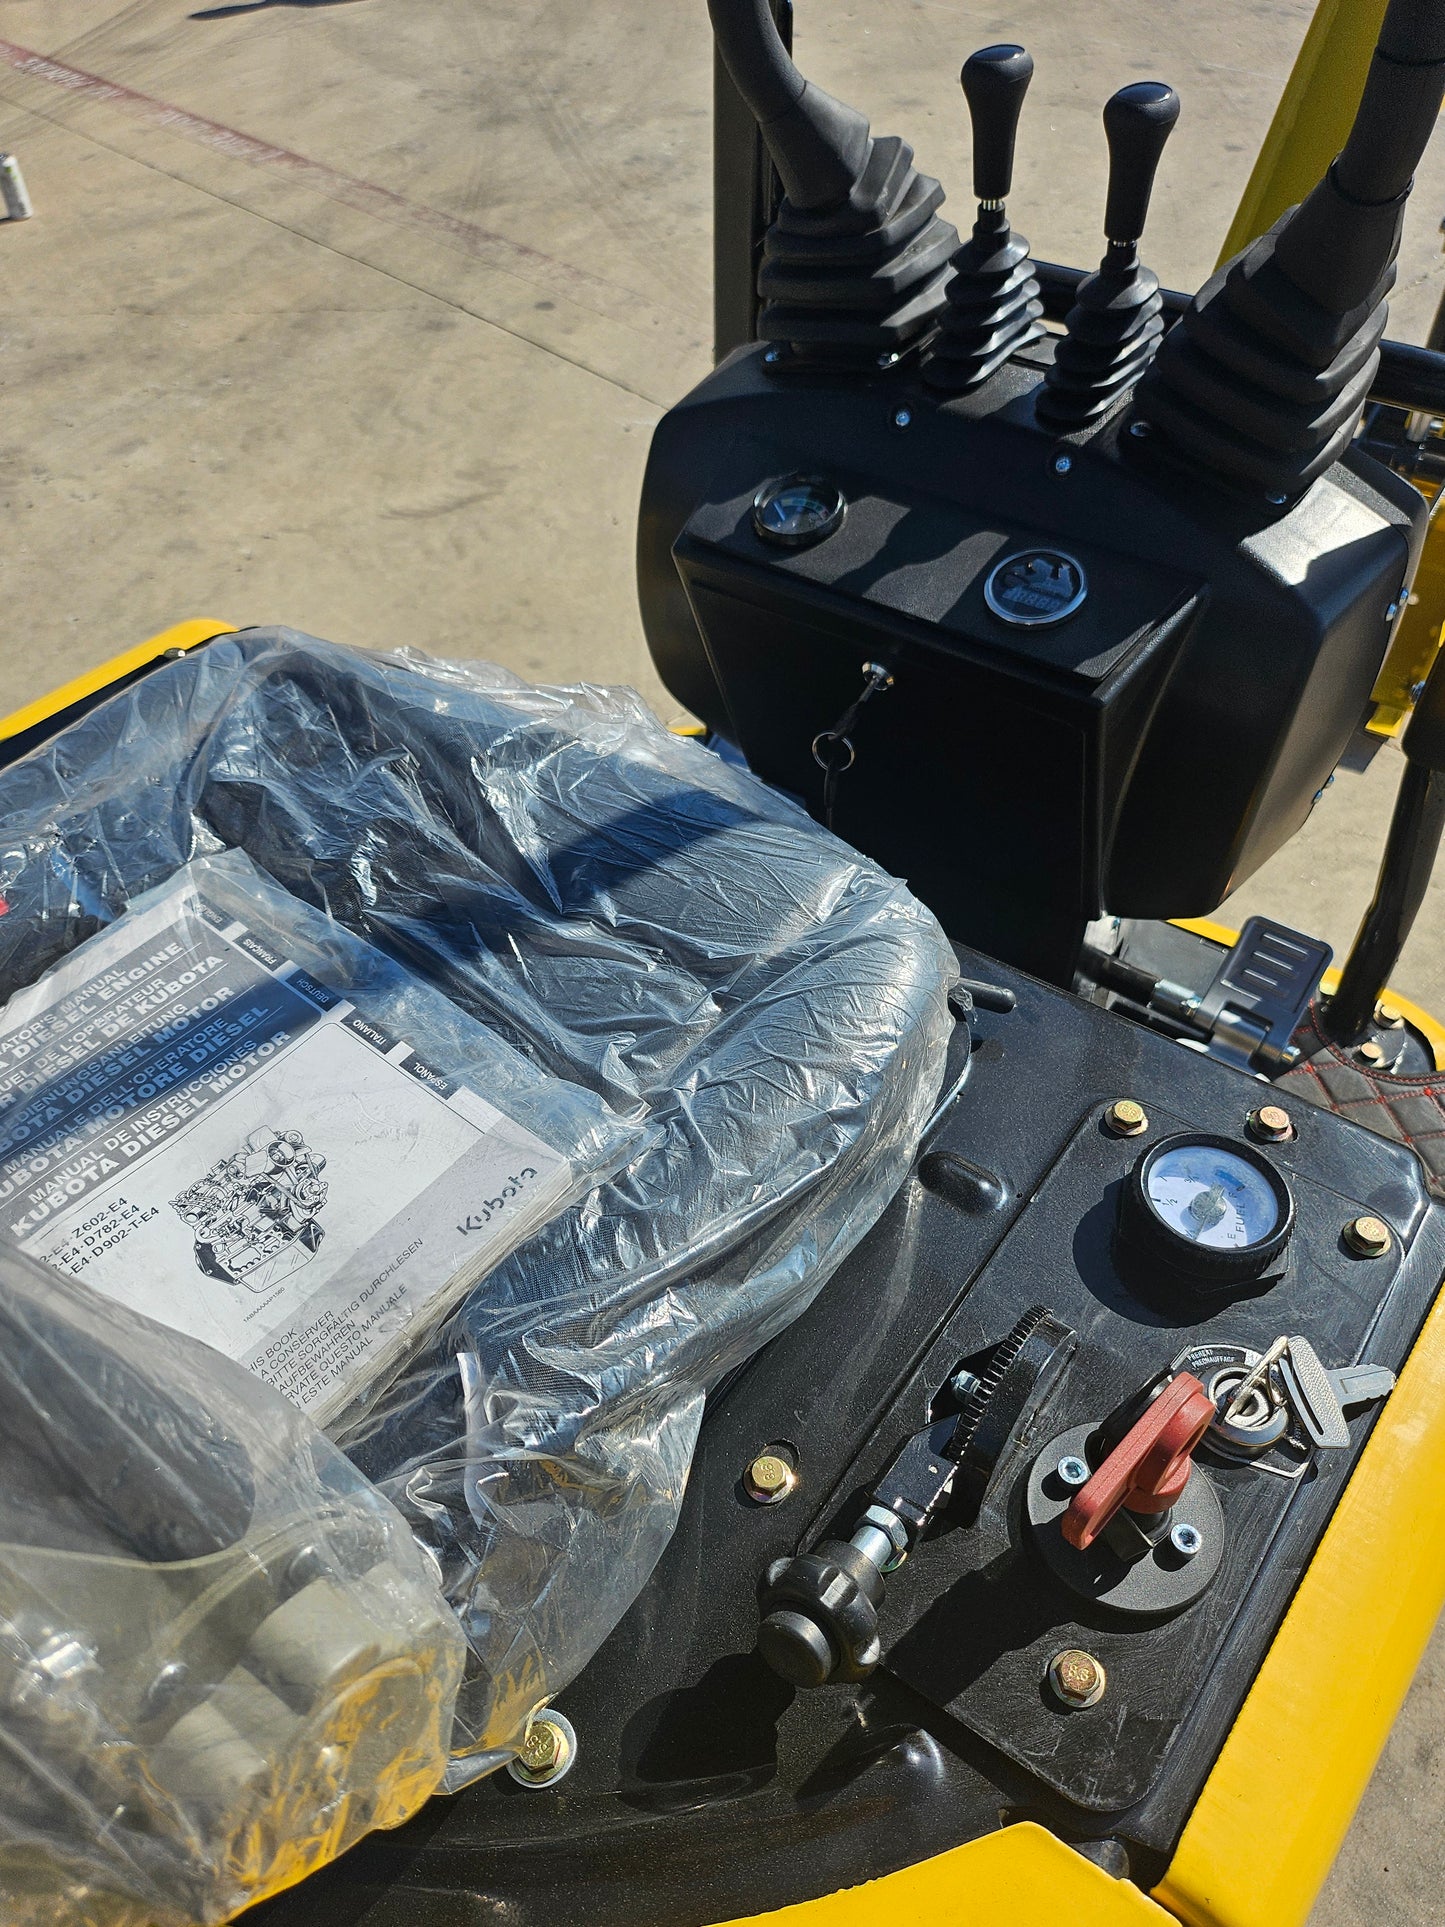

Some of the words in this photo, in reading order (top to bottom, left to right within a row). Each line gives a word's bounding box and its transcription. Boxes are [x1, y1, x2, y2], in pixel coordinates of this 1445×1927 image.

[243, 938, 277, 965] FRANÇAIS
[0, 1013, 58, 1054] ATOR'S
[59, 969, 126, 1014] MANUAL
[12, 1003, 97, 1059] DIESEL
[97, 941, 184, 1001] ENGINE
[18, 1039, 101, 1094] DIESEL
[100, 1014, 134, 1038] DE
[136, 954, 223, 1016] KUBOTA
[296, 978, 330, 1004] DEUTSCH
[352, 1018, 388, 1045] ITALIANO
[0, 1106, 64, 1153] BOTA
[65, 1043, 152, 1105] DIESEL
[152, 986, 235, 1045] MOTOR
[0, 1069, 35, 1093] UEL
[34, 1050, 60, 1069] DE
[0, 1135, 83, 1198] UBOTA
[85, 1059, 188, 1135] MOTORE
[191, 1006, 269, 1065] DIESEL
[4, 1112, 88, 1175] MANUALE
[88, 1016, 229, 1115] DELL'OPERATORE
[412, 1061, 448, 1089] ESPAÑOL
[11, 1159, 120, 1238] KUBOTA
[121, 1096, 210, 1158] DIESEL
[208, 1031, 291, 1094] MOTOR
[29, 1148, 104, 1205] MANUAL
[104, 1129, 132, 1151] DE
[130, 1040, 258, 1137] INSTRUCCIONES
[456, 1167, 538, 1236] Kubota
[1235, 1202, 1246, 1233] FUEL
[266, 1356, 297, 1386] BITTE
[299, 1301, 360, 1360] SORGFÄLTIG
[359, 1238, 423, 1303] DURCHLESEN
[266, 1328, 297, 1359] BOOK
[270, 1311, 335, 1369] CONSERVER
[286, 1371, 319, 1401] RVATE
[319, 1331, 361, 1371] QUESTO
[362, 1283, 407, 1331] MANUALE
[279, 1319, 356, 1392] AUFBEWAHREN
[302, 1377, 331, 1404] ESTE
[332, 1338, 373, 1377] MANUAL
